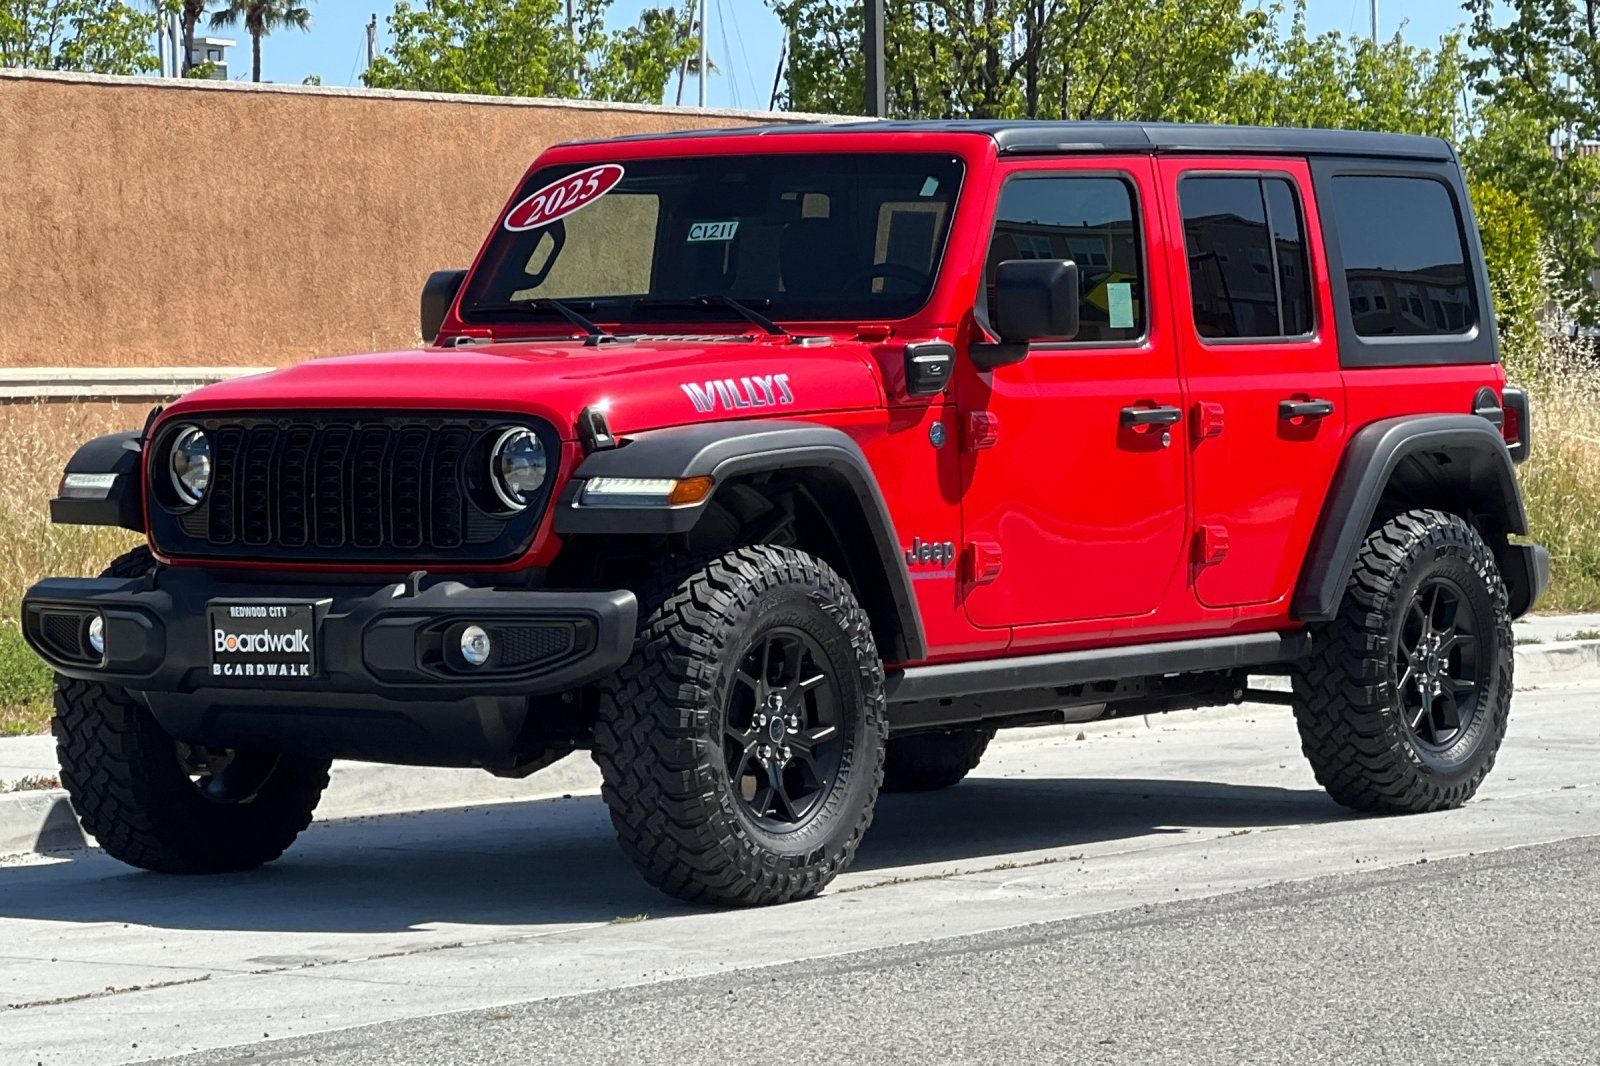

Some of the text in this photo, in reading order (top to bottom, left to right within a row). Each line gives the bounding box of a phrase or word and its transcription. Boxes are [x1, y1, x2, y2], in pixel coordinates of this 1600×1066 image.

[523, 169, 605, 226] 2025
[690, 224, 733, 239] C1211
[680, 373, 794, 413] WILLYS
[905, 536, 956, 568] Jeep
[230, 606, 287, 617] REDWOOD CITY
[214, 629, 310, 652] Boardwalk
[212, 663, 309, 676] BOARDWALK
